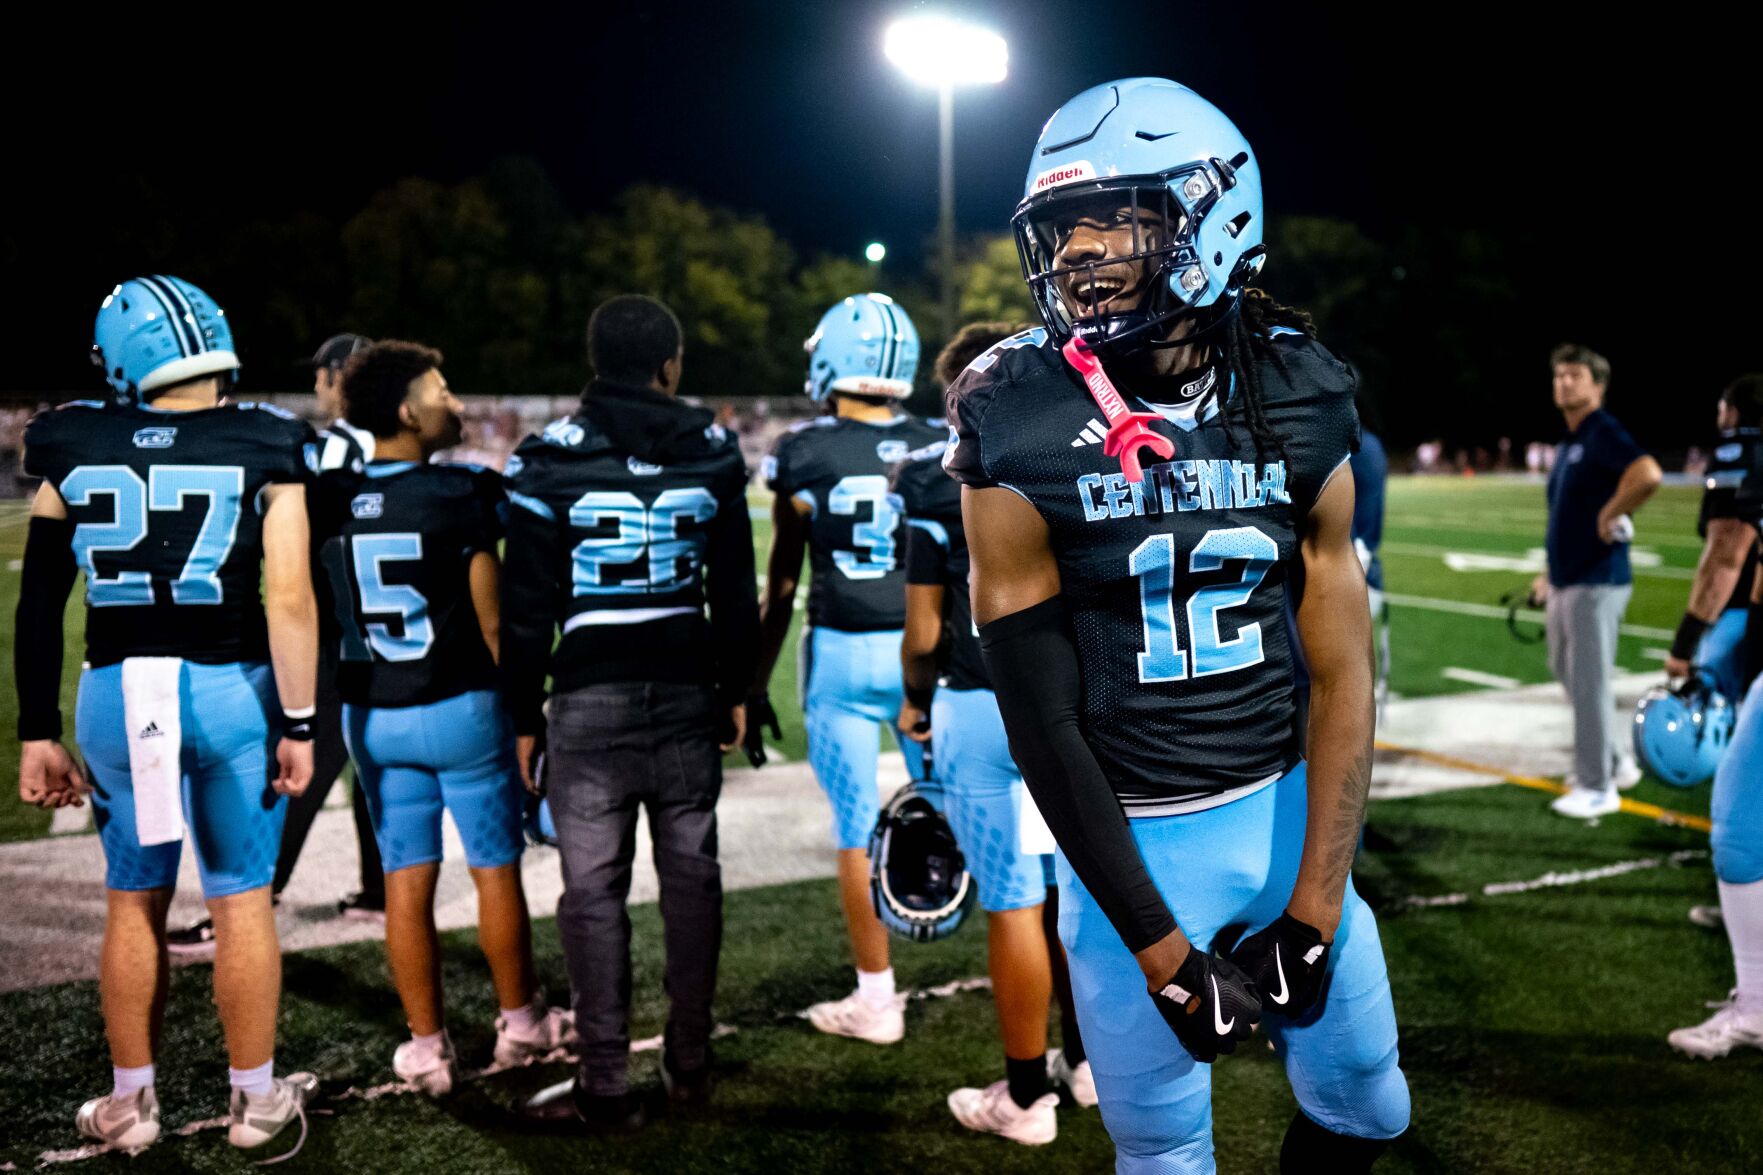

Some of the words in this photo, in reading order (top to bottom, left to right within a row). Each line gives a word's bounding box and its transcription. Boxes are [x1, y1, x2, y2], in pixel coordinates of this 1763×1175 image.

[1089, 372, 1124, 420] NXTRND
[60, 464, 245, 607] 27
[568, 487, 718, 598] 26
[1076, 459, 1292, 522] CENTENNIAL
[1128, 526, 1279, 684] 12
